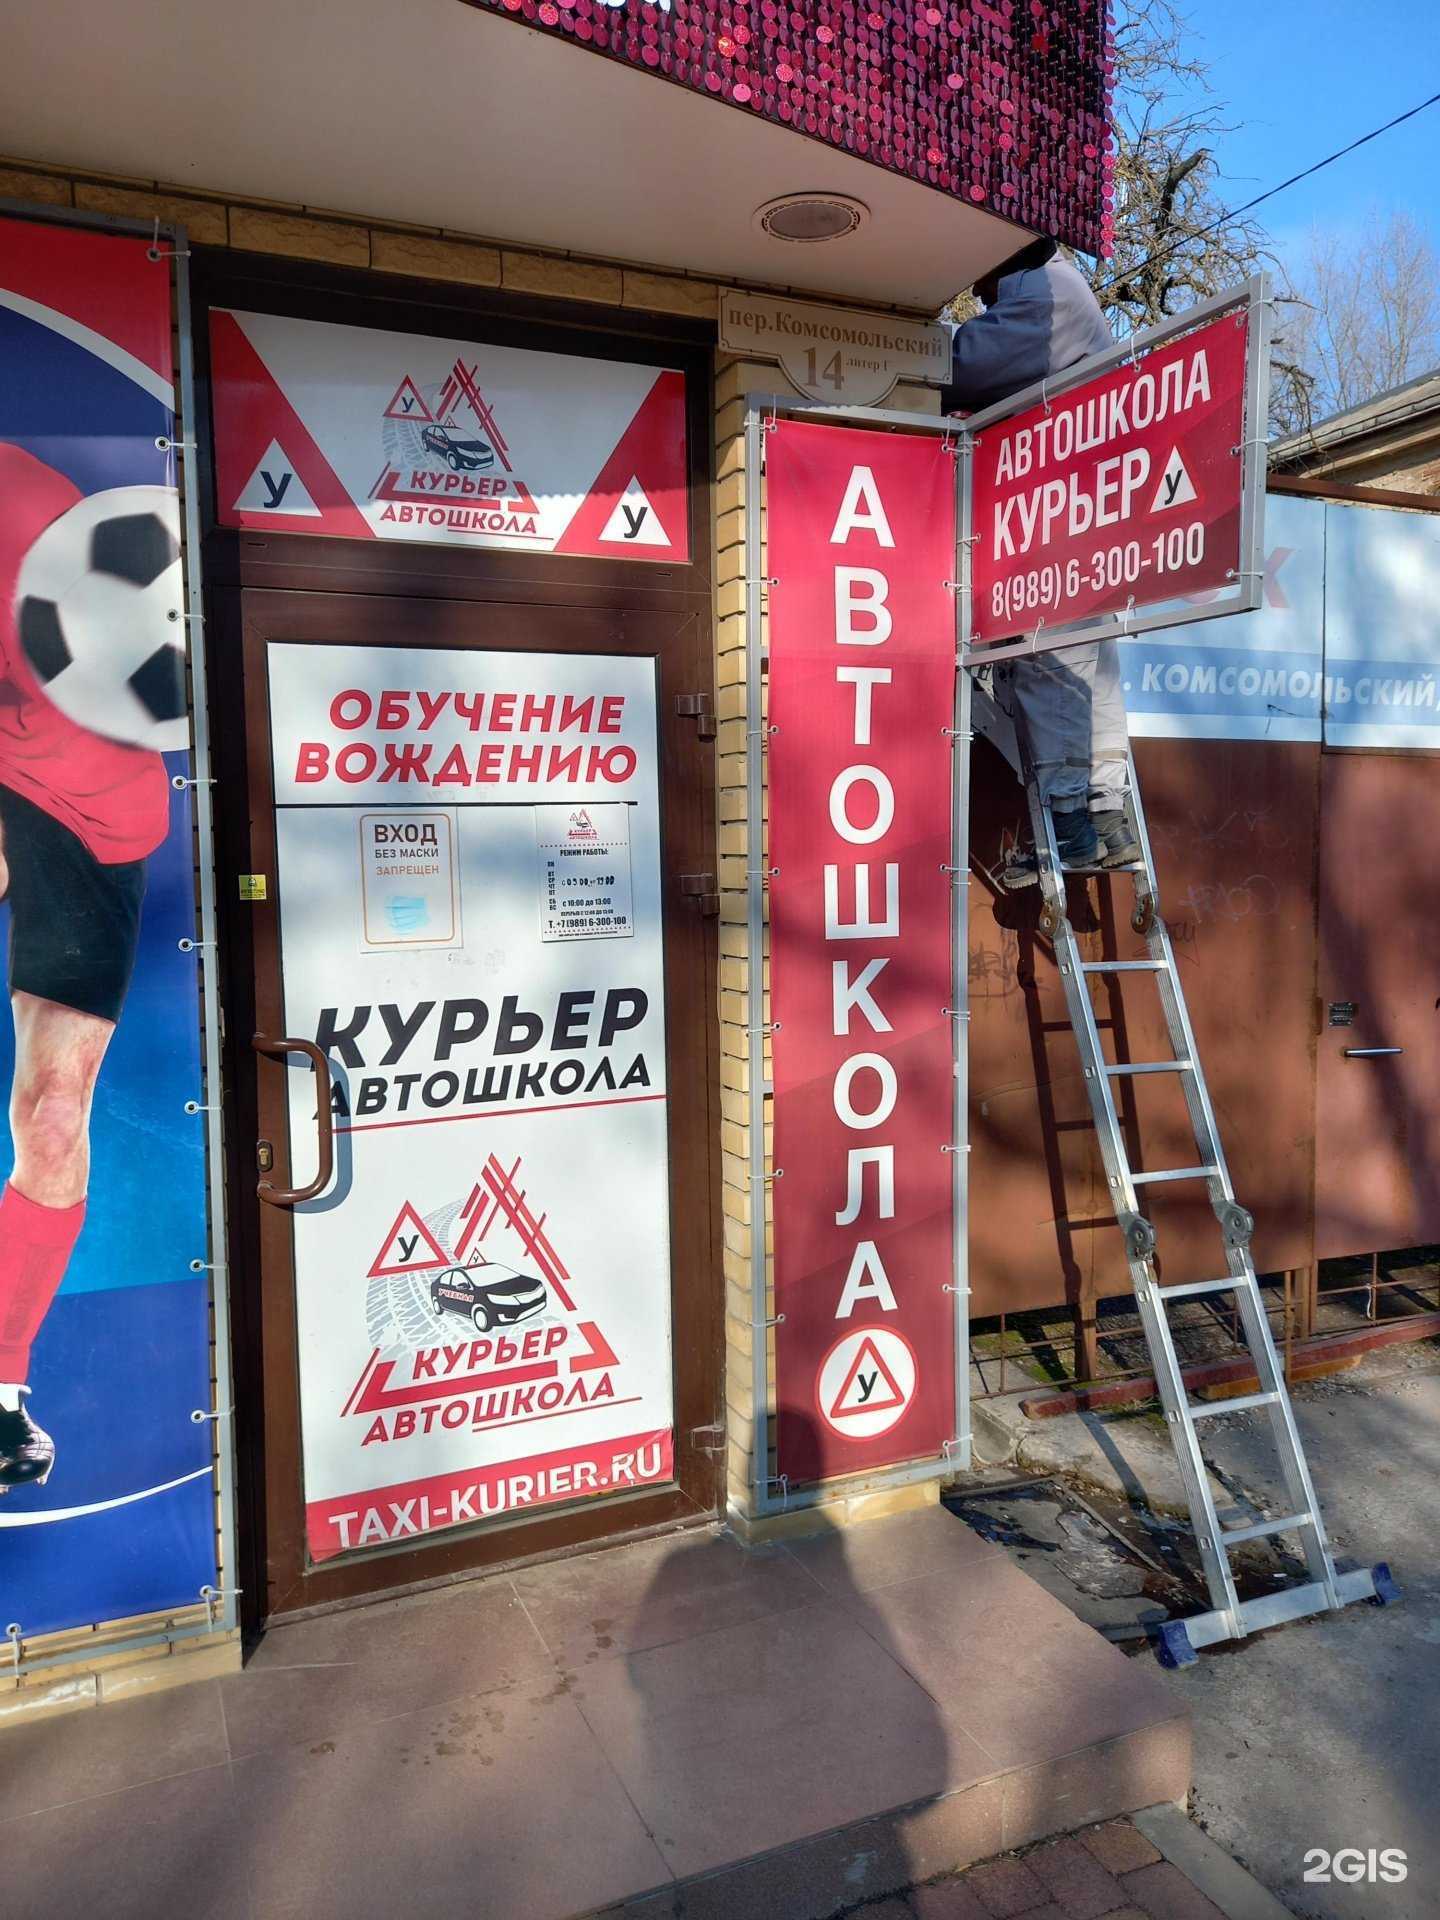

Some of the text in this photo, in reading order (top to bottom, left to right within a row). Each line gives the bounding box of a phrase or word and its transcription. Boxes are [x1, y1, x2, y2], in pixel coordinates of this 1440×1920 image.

[802, 347, 845, 390] 14
[995, 349, 1211, 486] АВТОШКОЛА
[410, 471, 508, 496] КУРЬЕР
[993, 447, 1151, 561] КУРЬЕР
[379, 504, 537, 533] АВТОШКОЛА
[329, 689, 625, 734] ОБУЧЕНИЕ
[295, 742, 638, 786] ВОЖДЕНИЮ
[374, 823, 438, 846] ВХОД
[375, 847, 439, 859] БЕЗ МАСКИ
[376, 864, 440, 876] ЗАПРЕЩЕН
[823, 464, 900, 1320] АВТОШКОЛА
[310, 987, 649, 1072] КУРЬЕР
[312, 1053, 651, 1120] АВТОШКОЛА
[412, 1326, 569, 1380] КУРЬЕР
[361, 1372, 615, 1446] АВТОШКОЛА
[329, 1443, 662, 1548] TAXI-KURIER.RU
